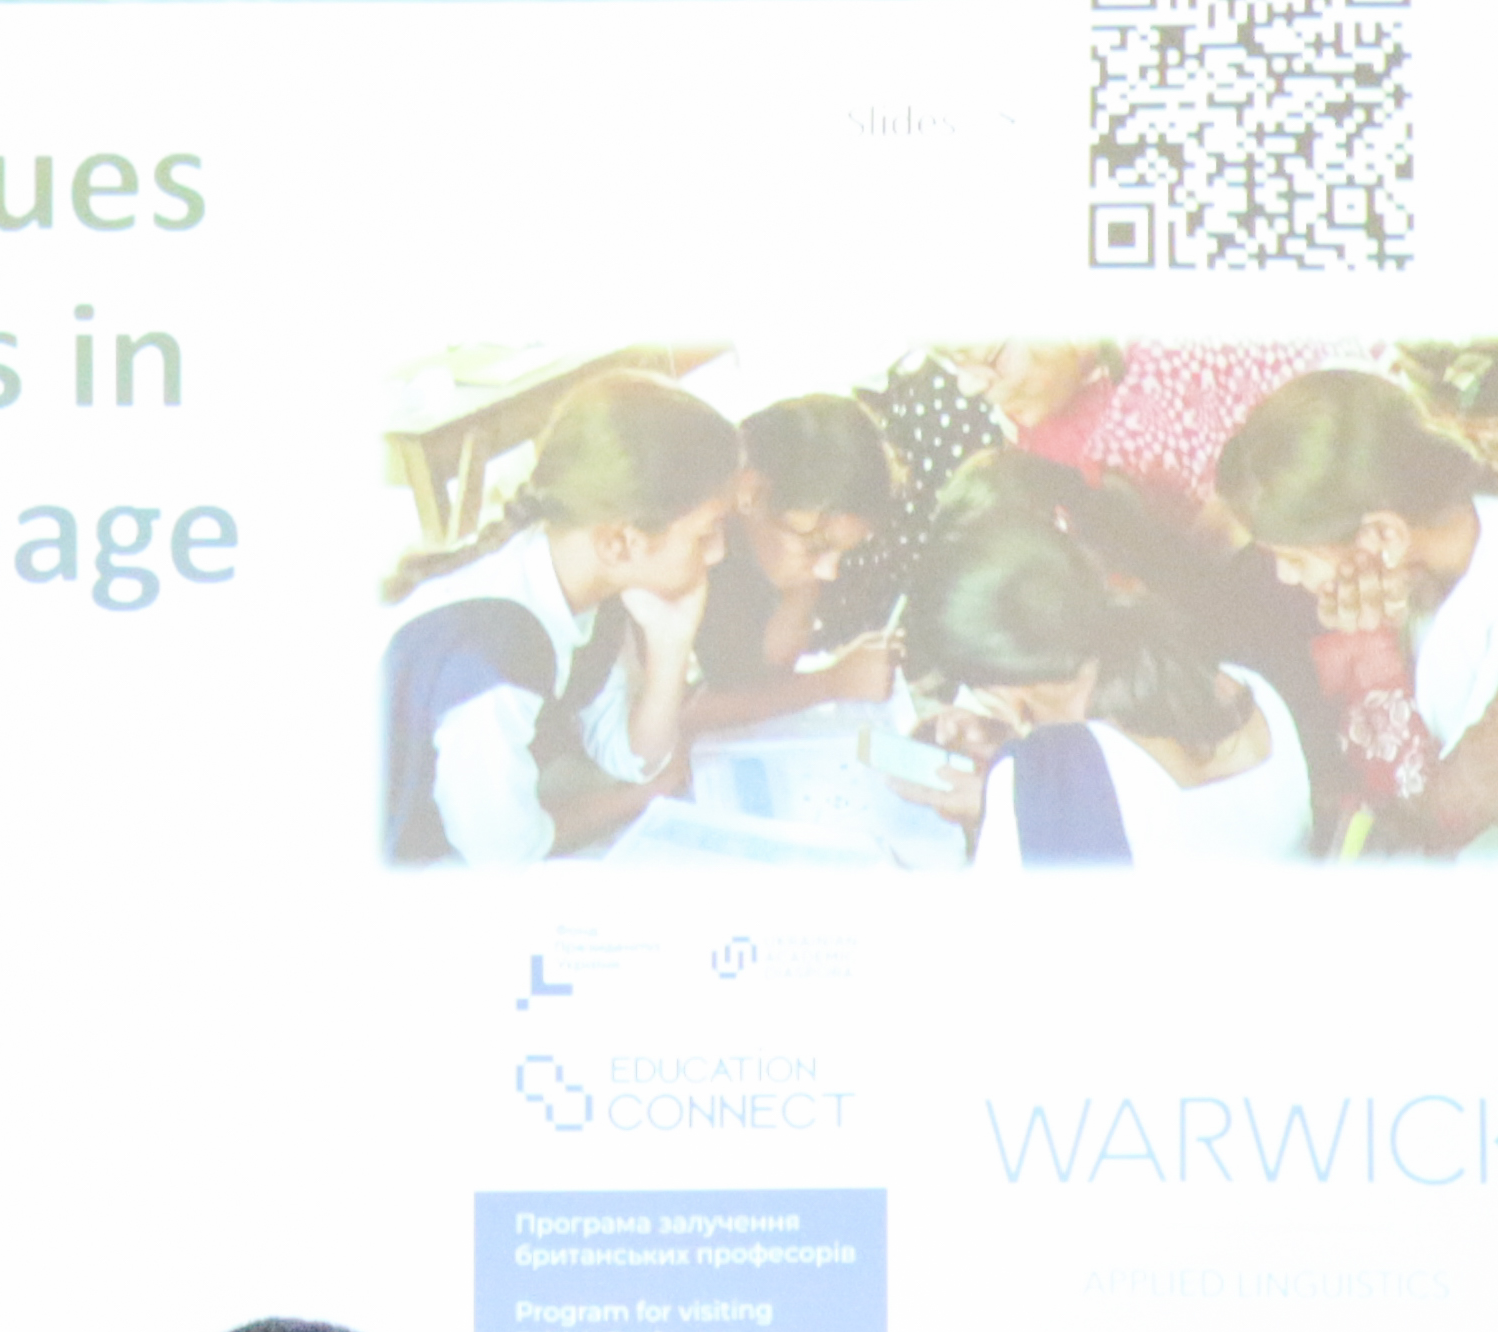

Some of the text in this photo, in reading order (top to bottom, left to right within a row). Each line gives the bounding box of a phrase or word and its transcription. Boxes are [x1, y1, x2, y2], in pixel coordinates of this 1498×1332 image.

[72, 301, 184, 409] in
[606, 1090, 857, 1133] CONNECT
[514, 1209, 800, 1237] Програма залучення
[514, 1241, 856, 1269] британських професорів
[1082, 1266, 1453, 1301] APPLIED LINGUISTICS
[514, 1299, 772, 1327] Program for visiting
